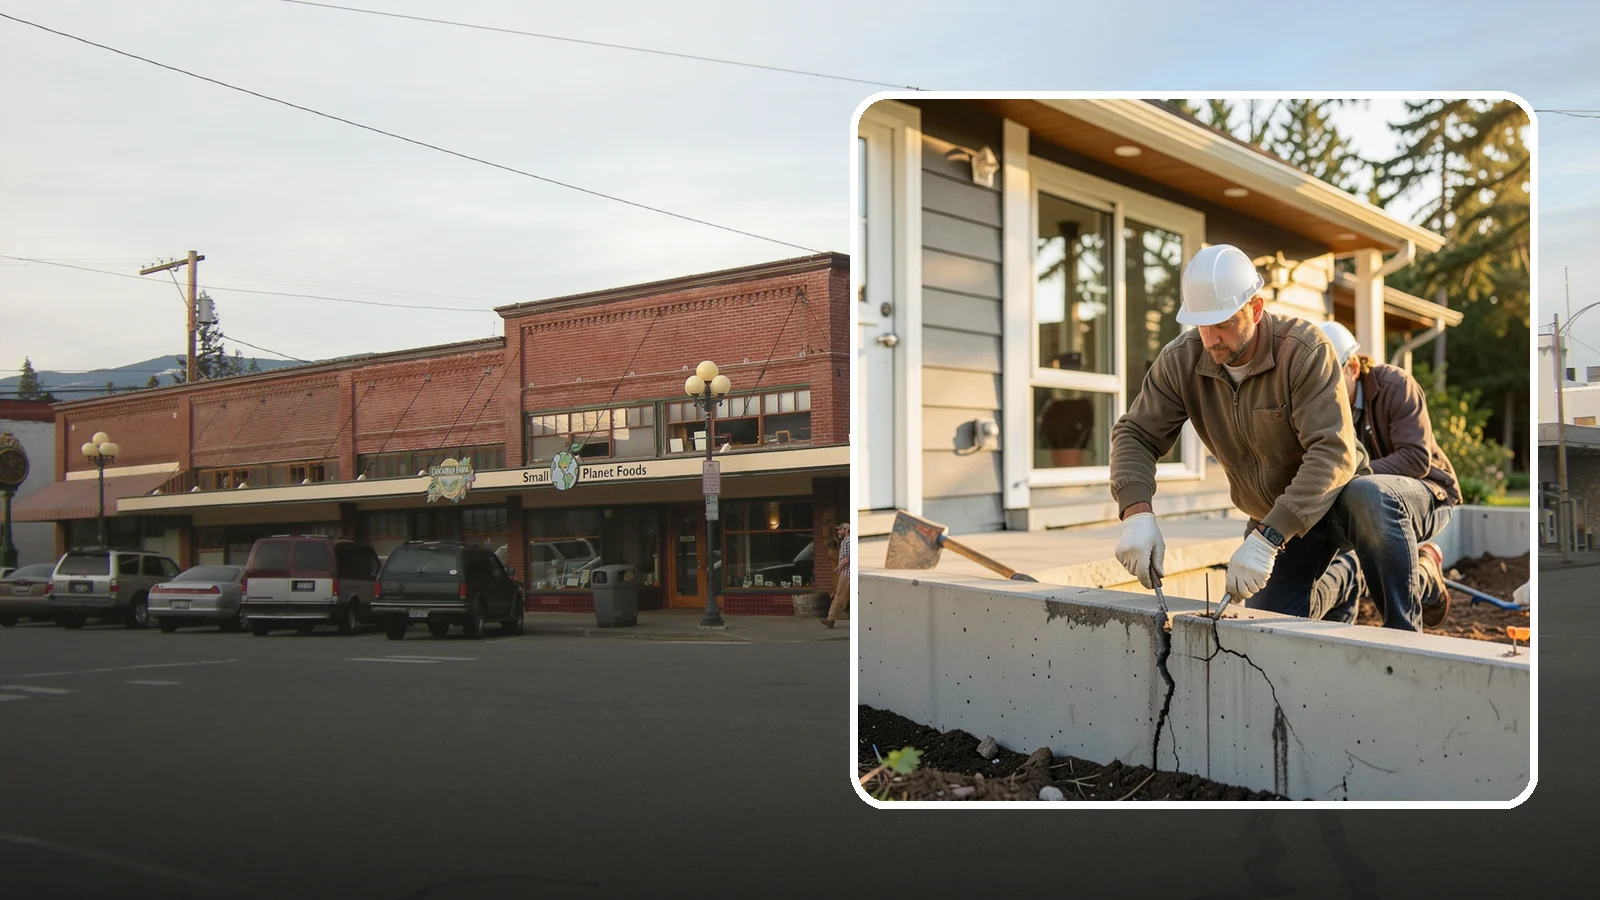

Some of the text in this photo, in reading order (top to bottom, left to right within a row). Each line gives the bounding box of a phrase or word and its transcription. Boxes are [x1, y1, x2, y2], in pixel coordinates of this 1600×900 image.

[523, 464, 647, 483] Small Planet Foods
